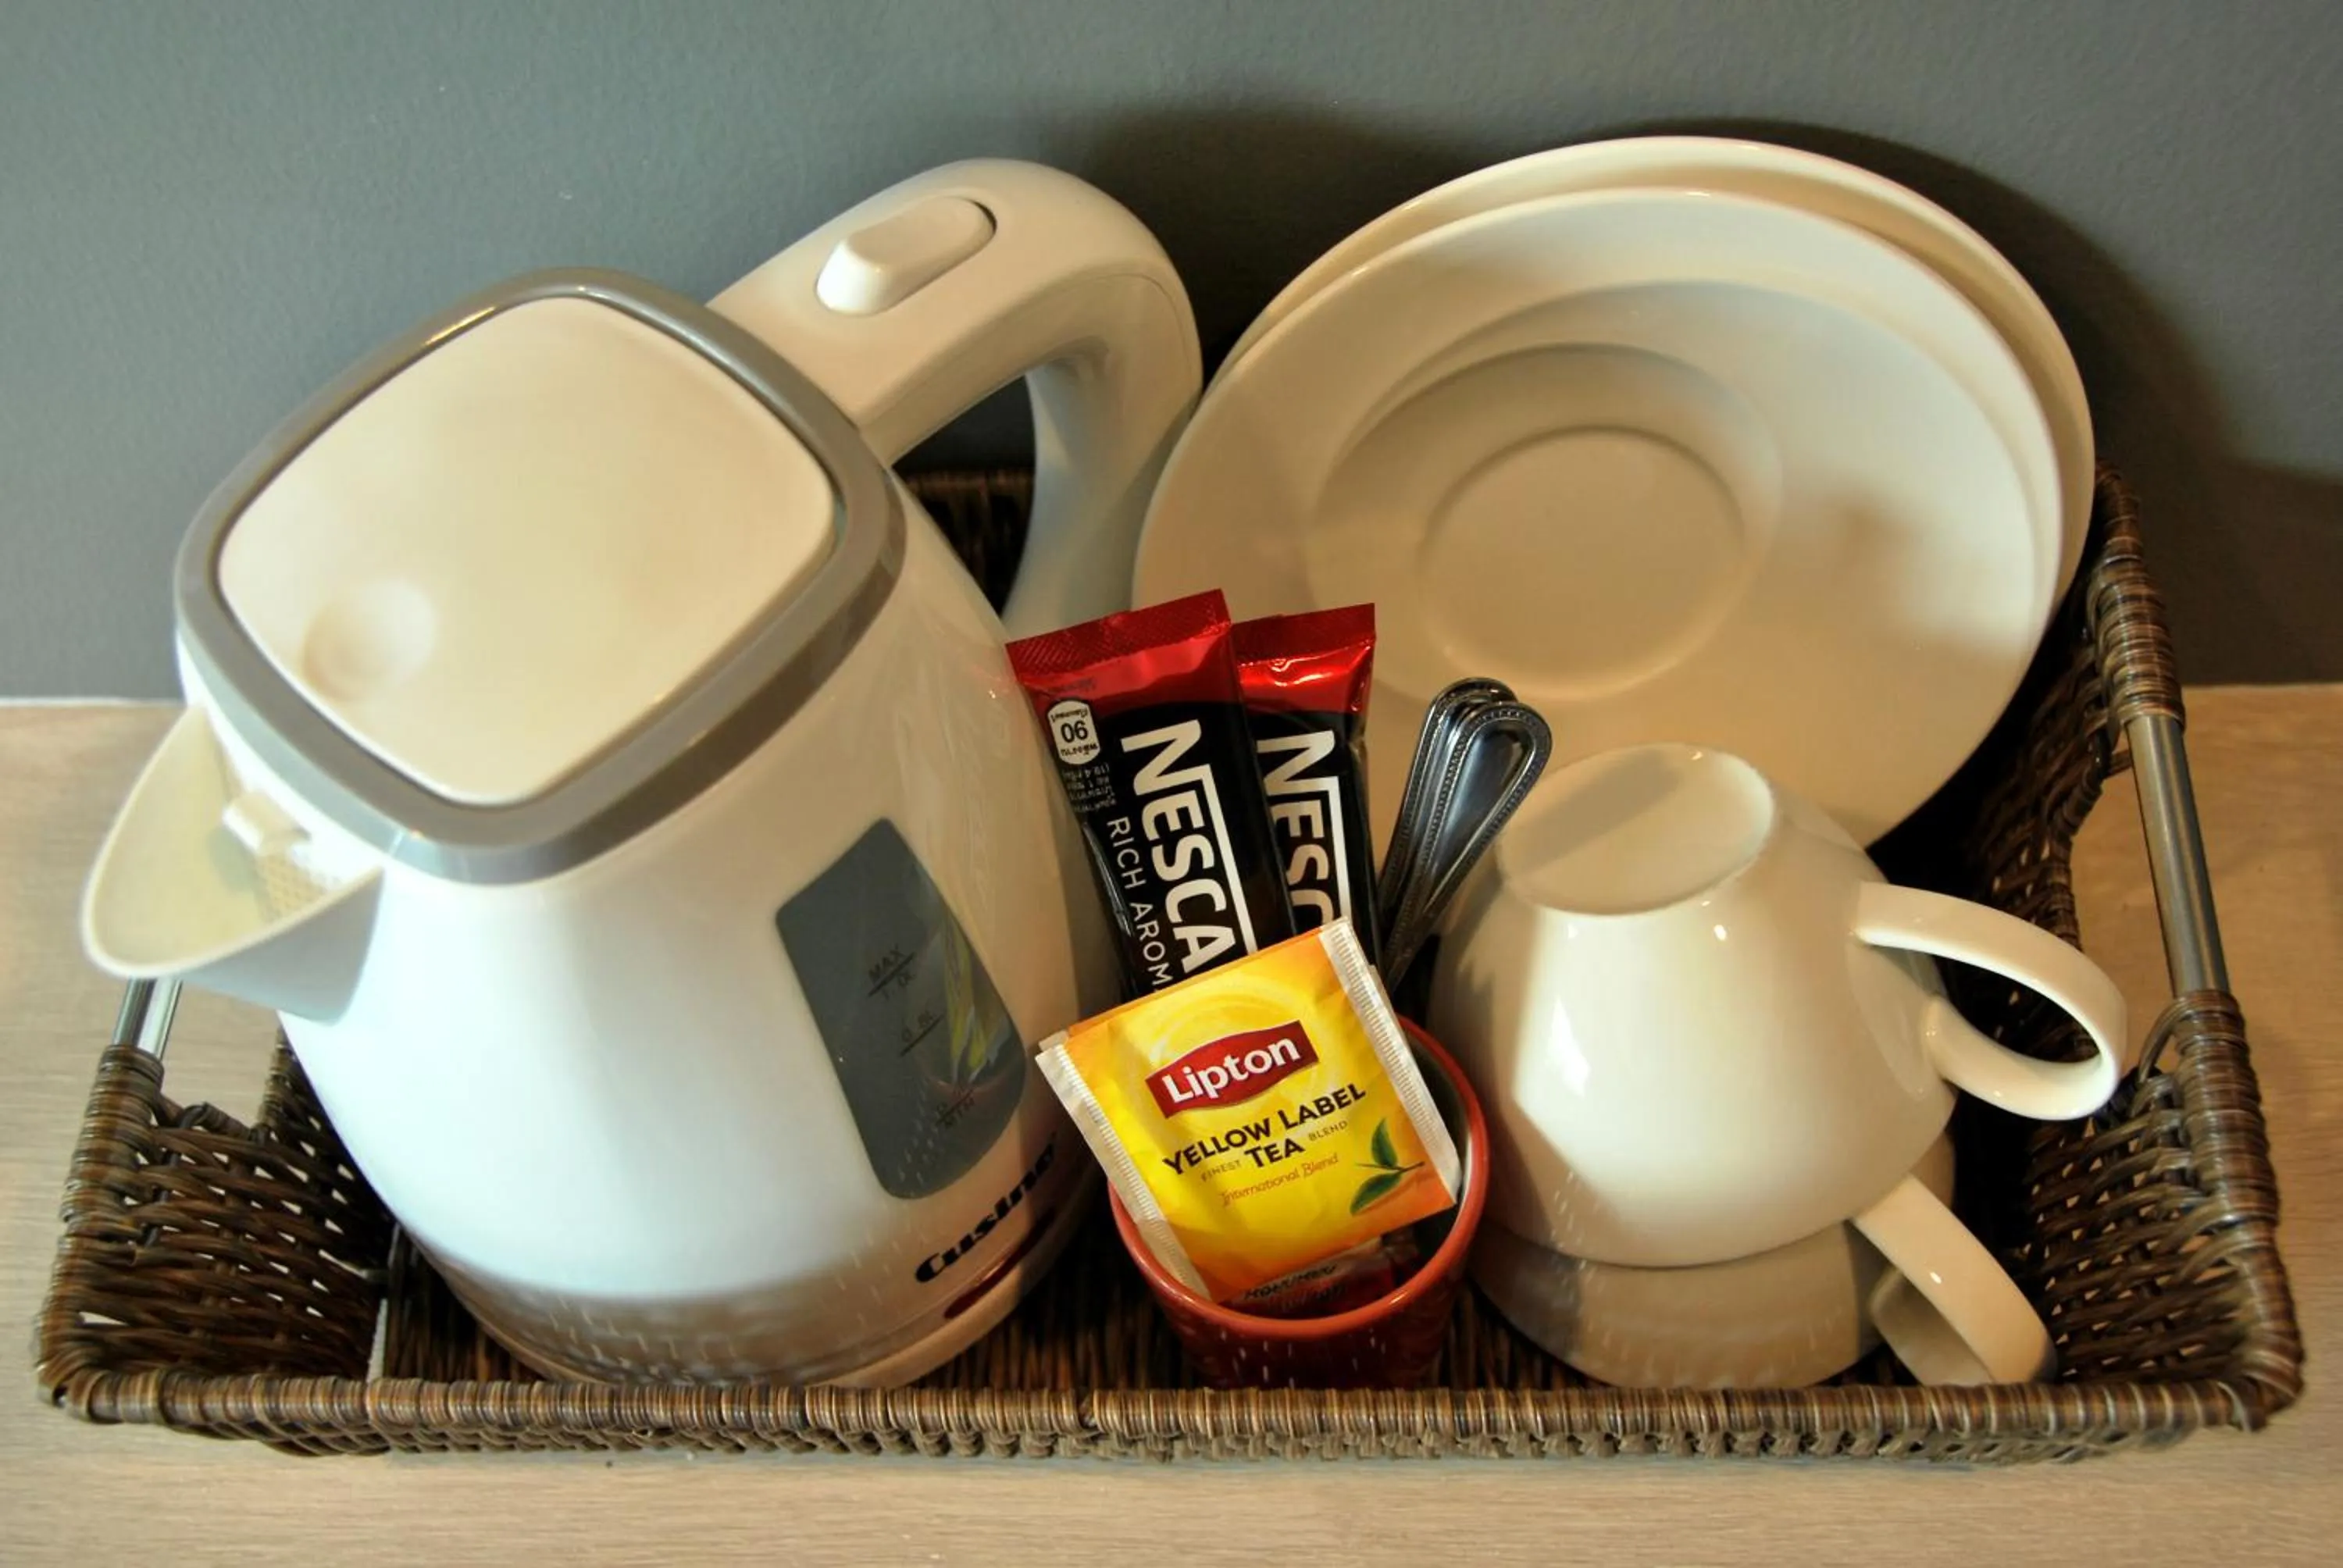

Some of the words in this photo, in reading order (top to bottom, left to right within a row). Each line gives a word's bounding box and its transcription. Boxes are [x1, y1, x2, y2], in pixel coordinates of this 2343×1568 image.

[1120, 718, 1257, 974] NESCA
[1256, 729, 1352, 927] NESC
[1106, 816, 1147, 889] RICH
[1129, 901, 1174, 992] AROM
[1161, 1037, 1301, 1104] Lipton
[1161, 1117, 1271, 1176] YELLOW
[1277, 1082, 1367, 1131] LABEL
[1200, 1158, 1242, 1183] FINEST
[1243, 1137, 1307, 1169] TEA
[1307, 1119, 1349, 1142] BLEND
[1219, 1167, 1301, 1208] International
[1300, 1152, 1339, 1180] Blend
